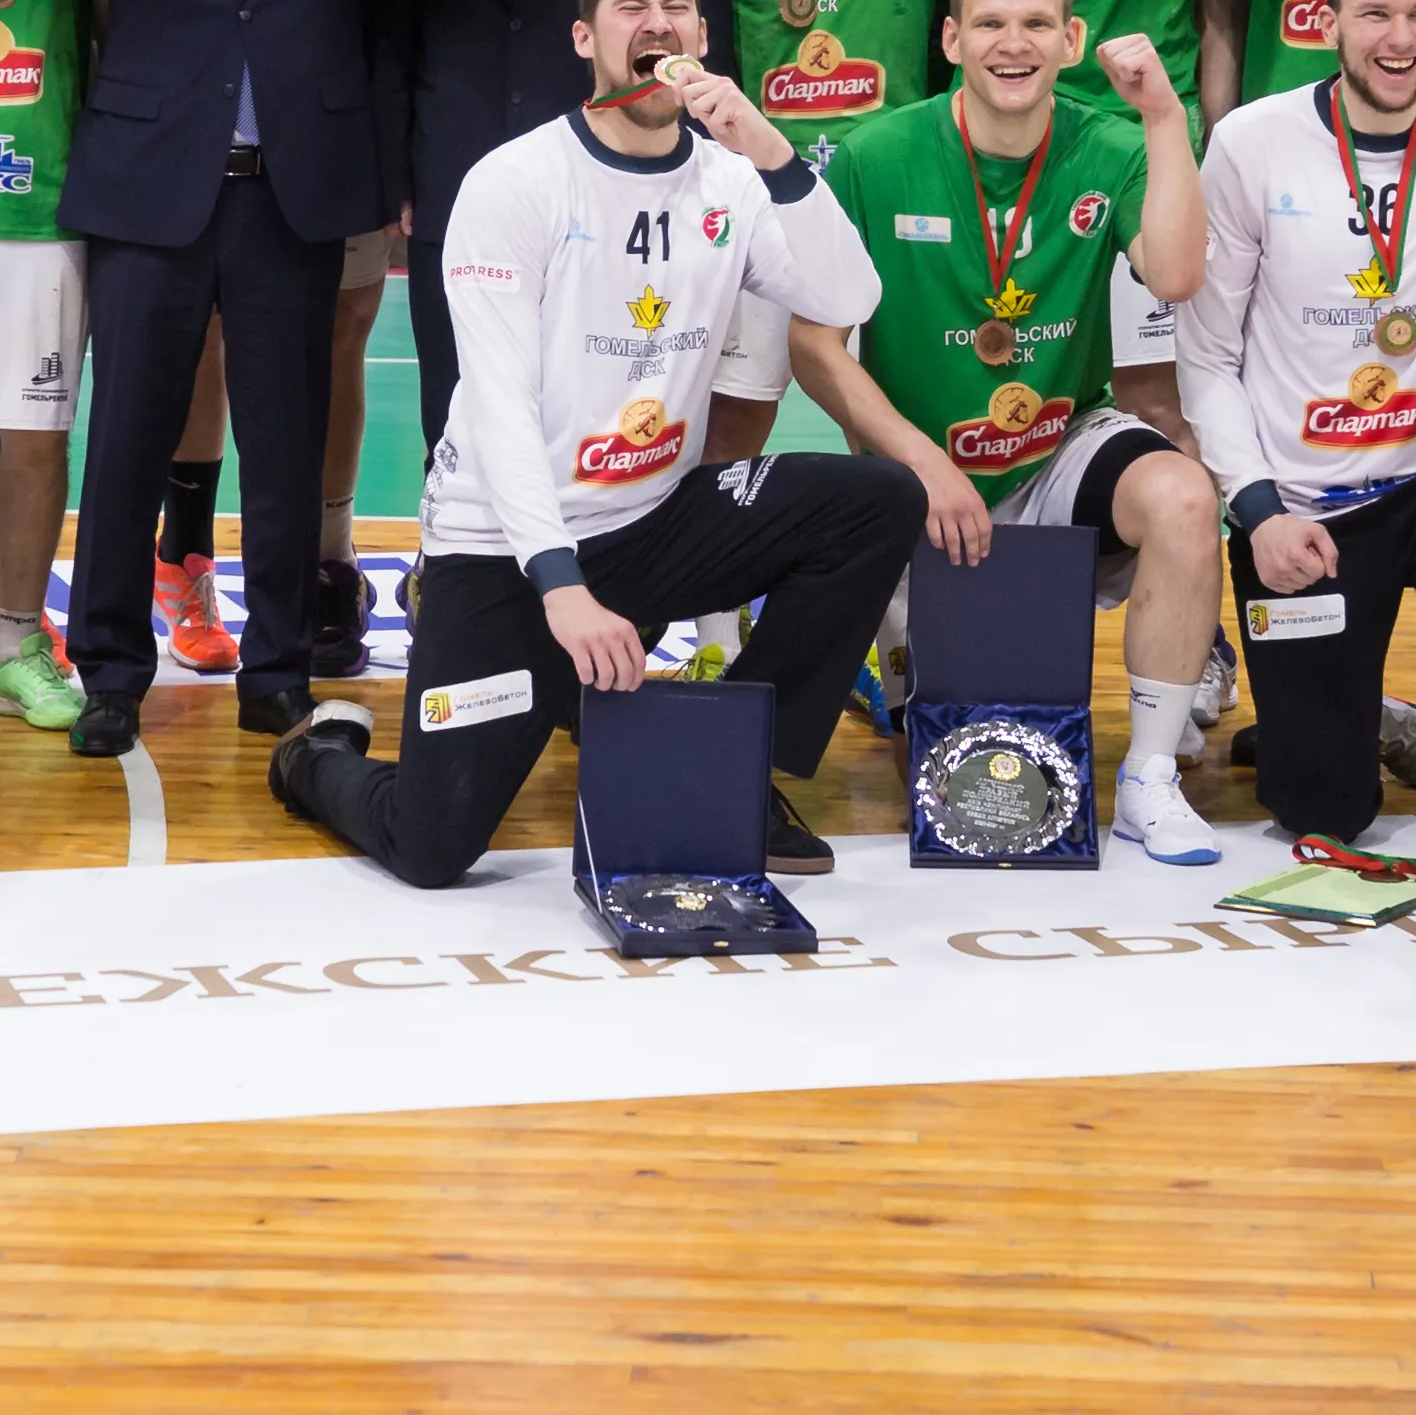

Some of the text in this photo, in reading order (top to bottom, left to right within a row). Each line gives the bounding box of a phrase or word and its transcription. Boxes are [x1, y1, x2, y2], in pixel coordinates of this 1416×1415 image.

[768, 75, 875, 102] Спартак
[626, 211, 670, 264] 41
[585, 327, 709, 357] ГОМЕЛЬСКИЙ
[627, 357, 666, 382] ДСК
[955, 416, 1068, 460] Спартак
[581, 437, 680, 472] Спартак
